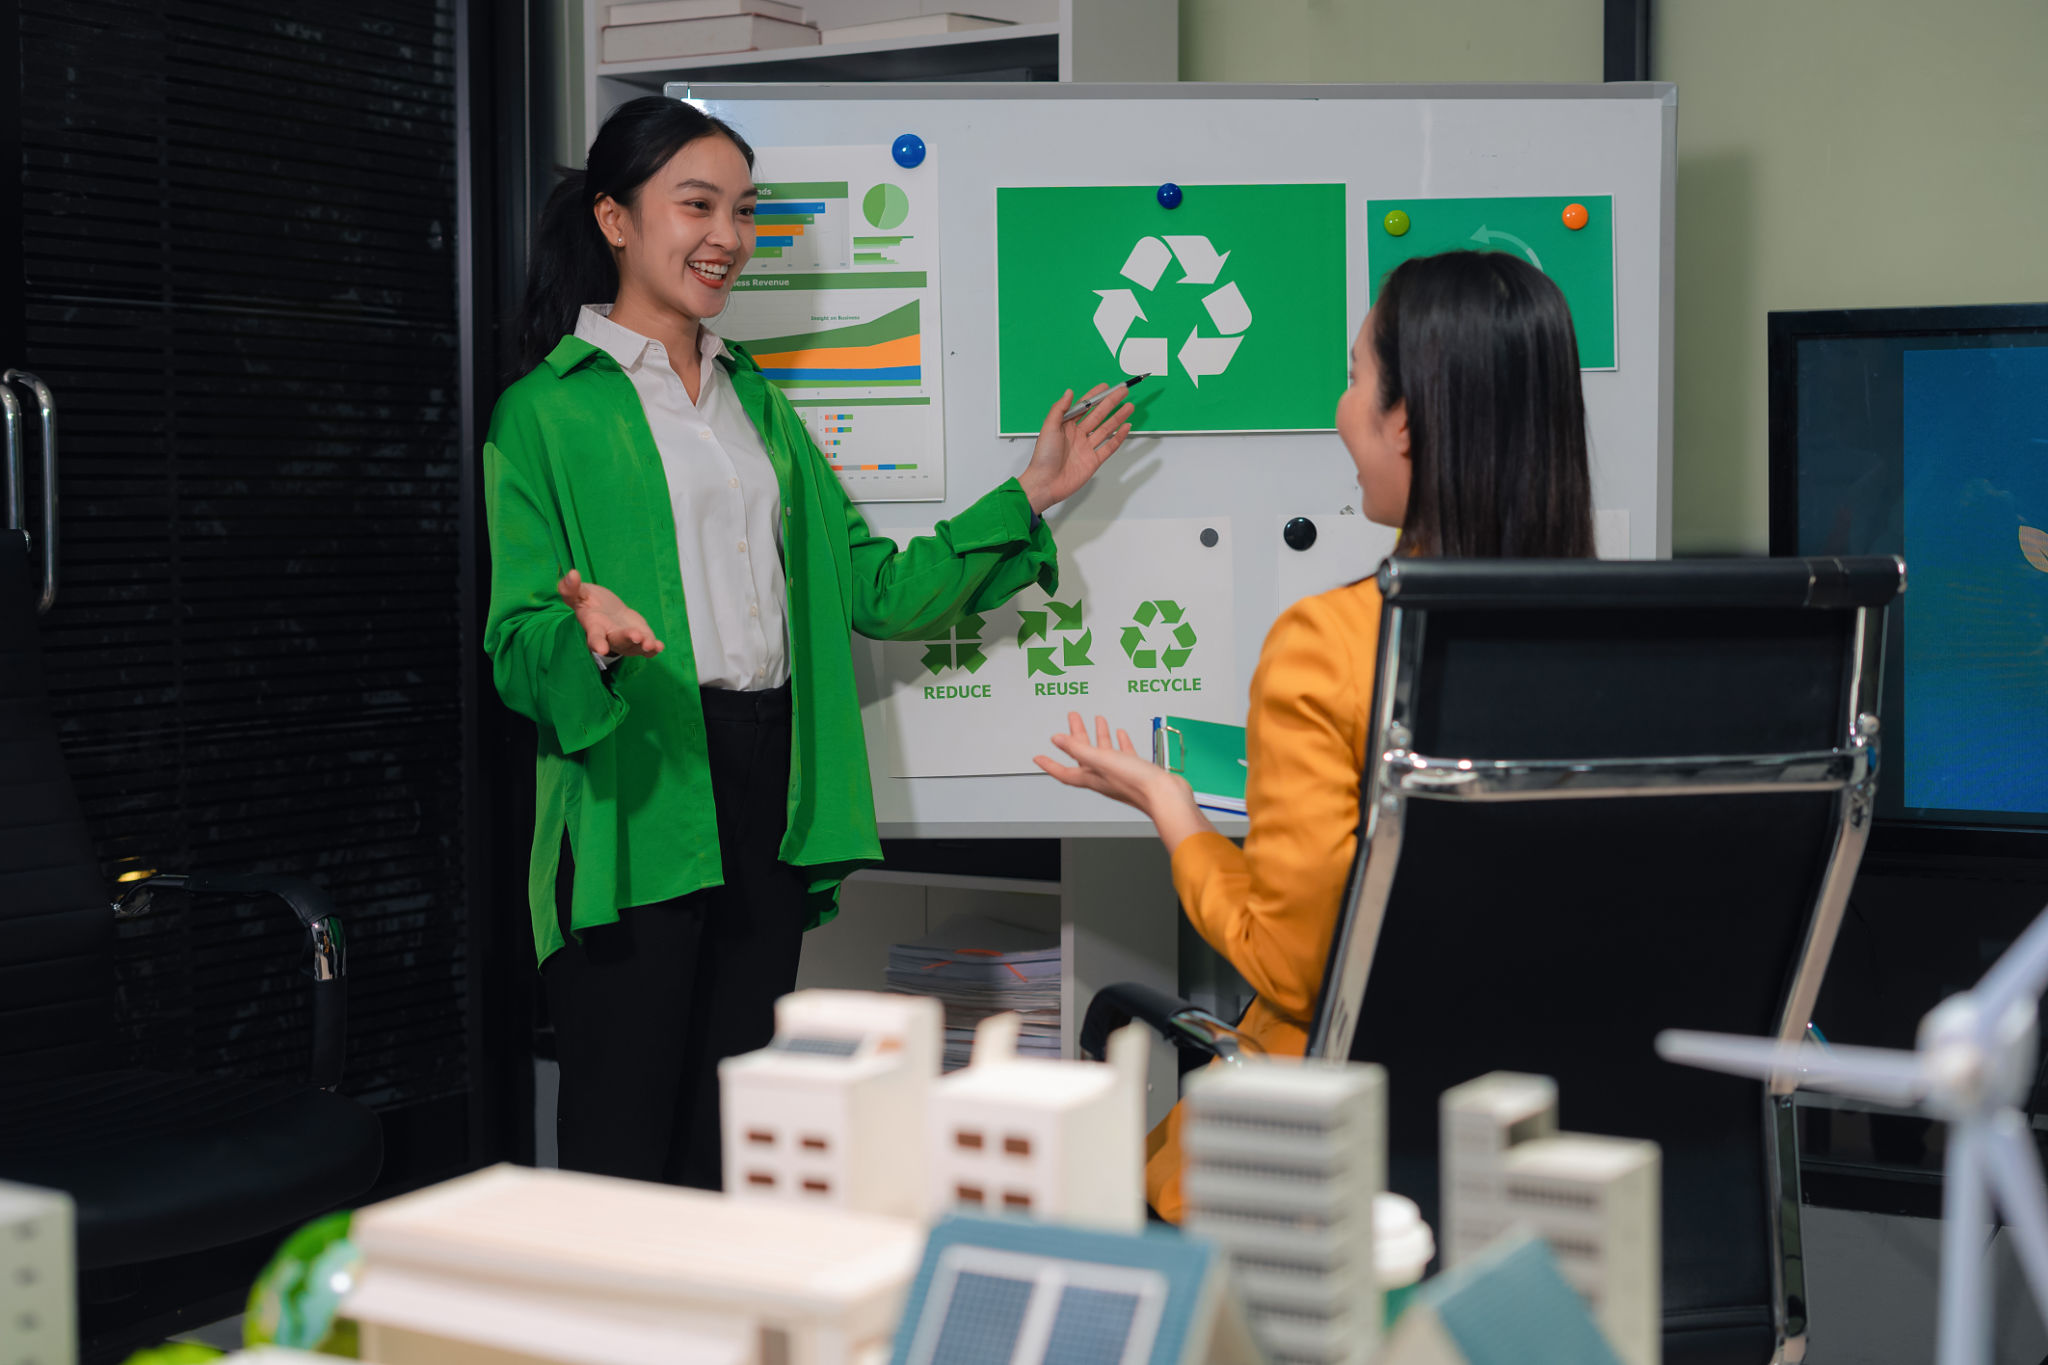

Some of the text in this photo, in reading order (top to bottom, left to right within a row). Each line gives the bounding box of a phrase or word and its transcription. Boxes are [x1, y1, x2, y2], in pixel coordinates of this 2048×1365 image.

[752, 278, 790, 286] Revenue
[924, 678, 1202, 700] REDUCE REUSE RECYCLE
